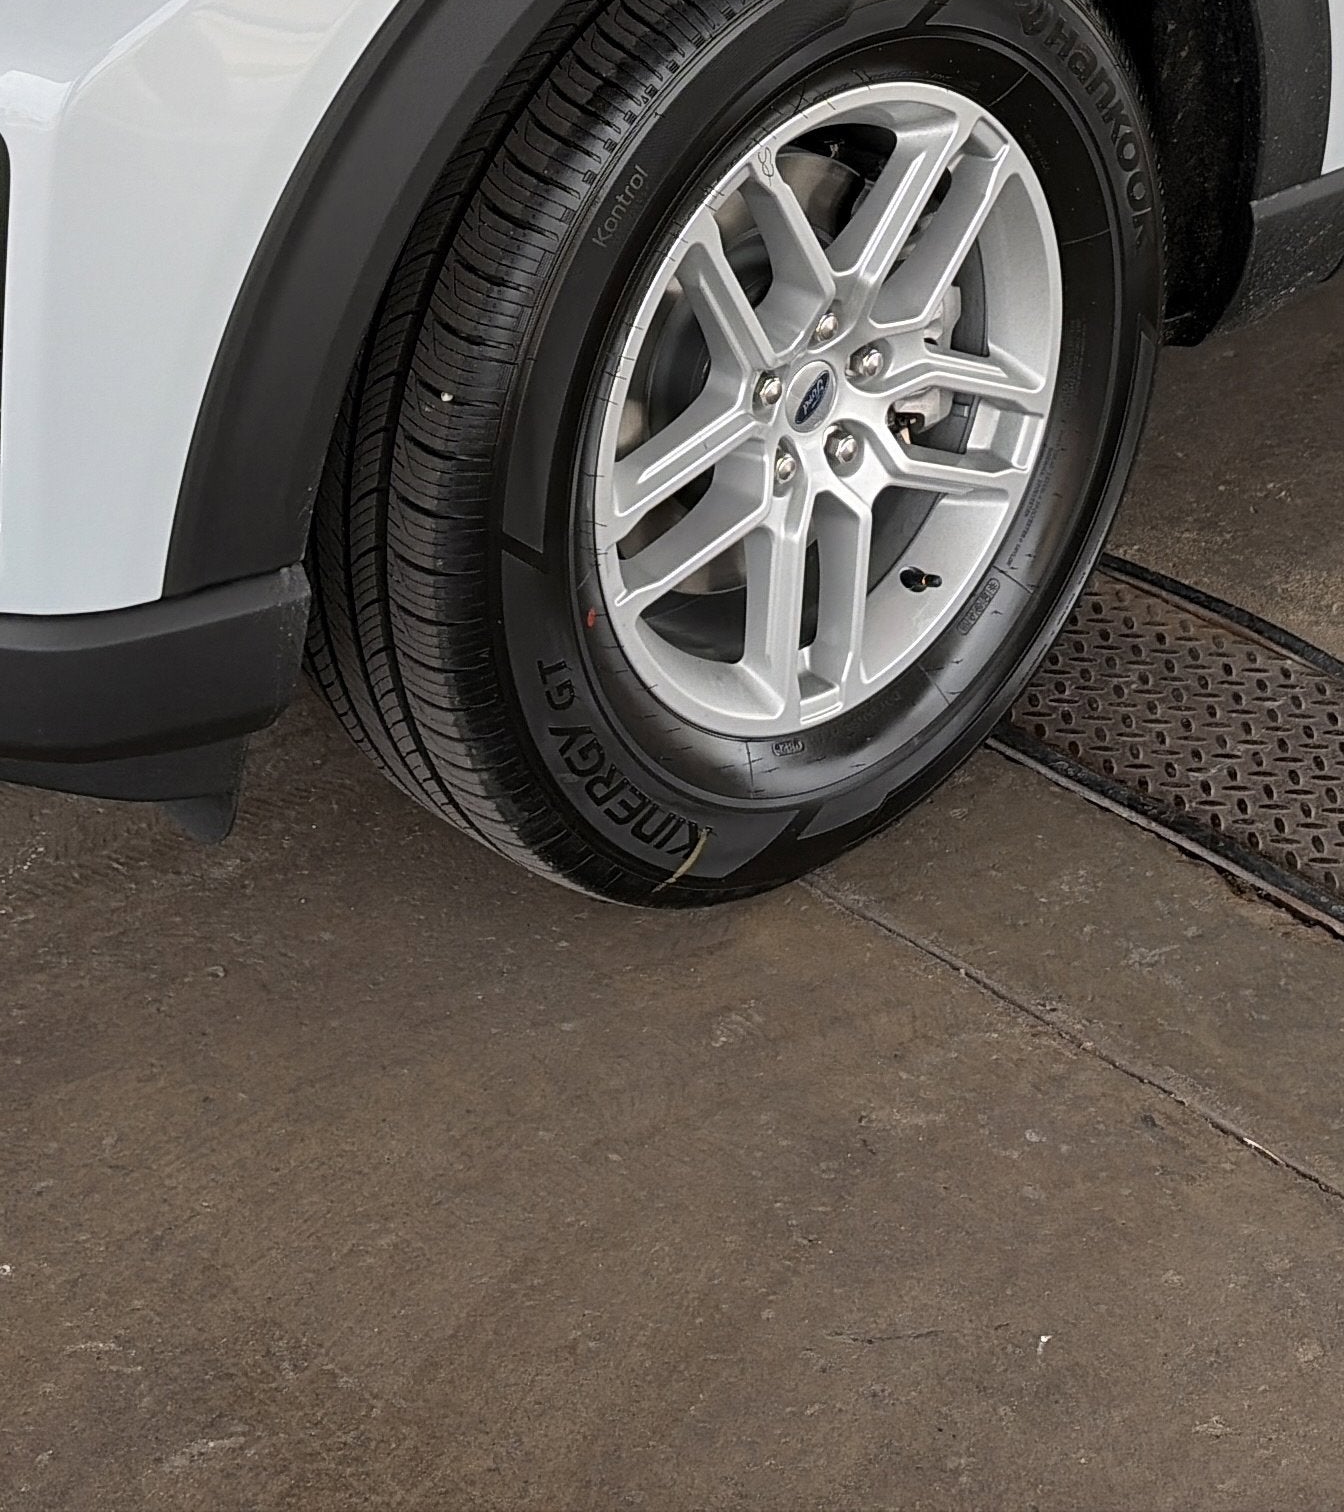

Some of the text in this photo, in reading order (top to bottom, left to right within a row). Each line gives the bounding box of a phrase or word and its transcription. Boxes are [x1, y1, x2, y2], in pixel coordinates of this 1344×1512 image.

[592, 164, 649, 248] Kontrol
[801, 378, 825, 416] Ford
[537, 659, 714, 859] KINERGY GT
